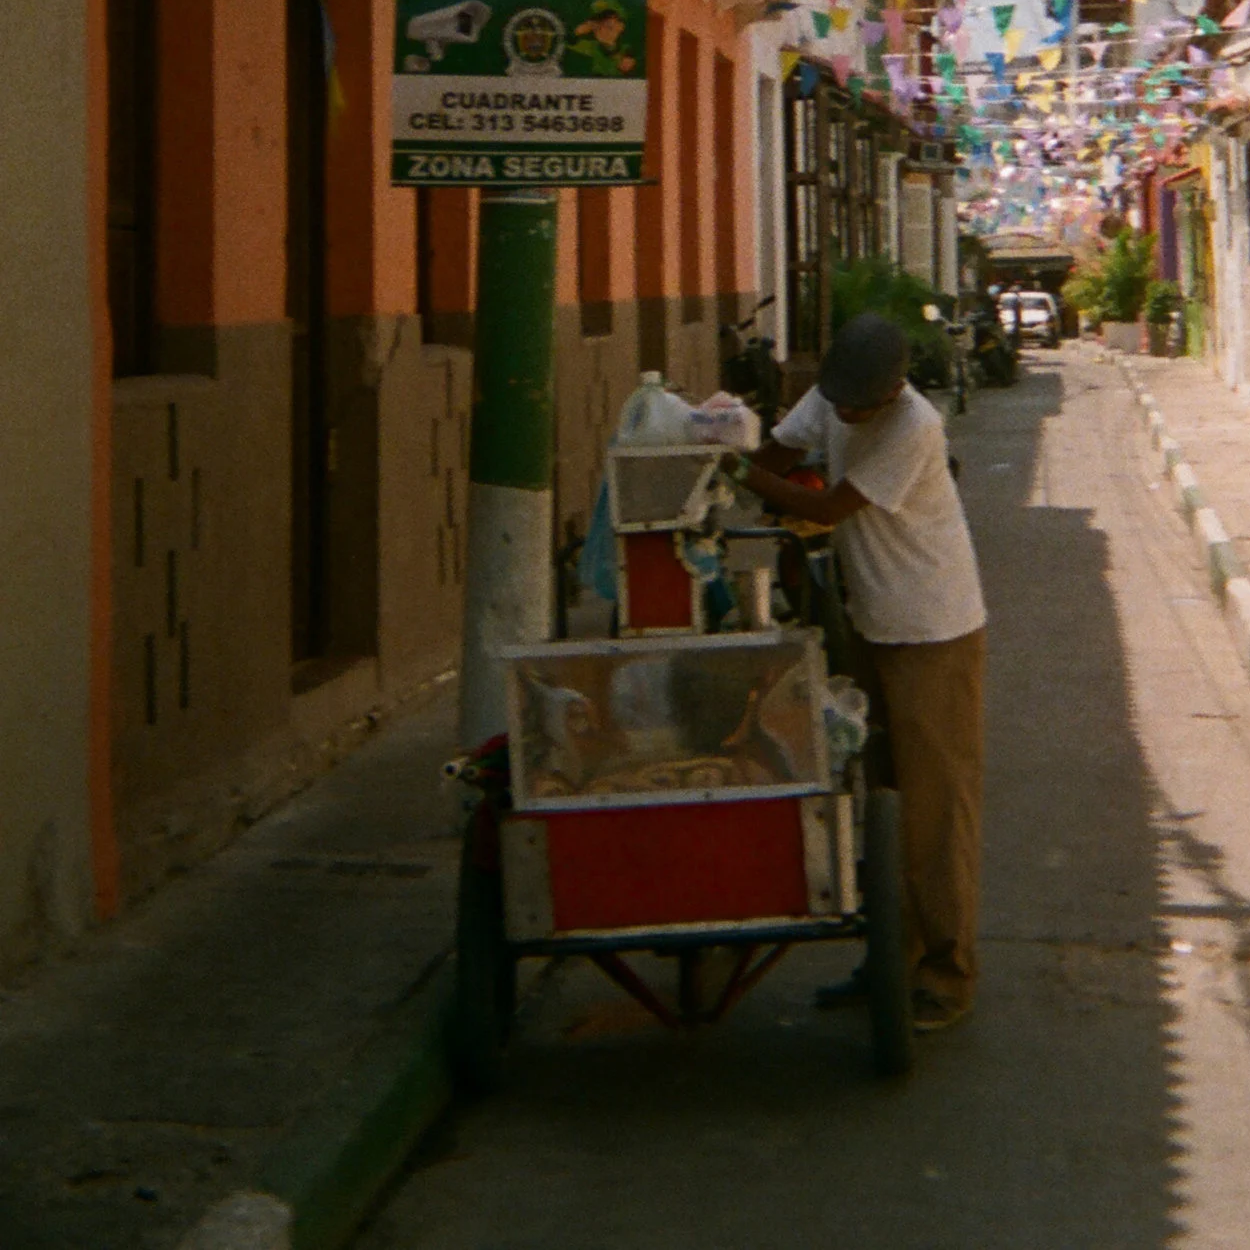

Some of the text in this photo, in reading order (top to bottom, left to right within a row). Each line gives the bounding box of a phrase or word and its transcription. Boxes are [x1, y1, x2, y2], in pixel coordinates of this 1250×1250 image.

[441, 92, 593, 111] CUADRANTE
[409, 113, 464, 131] CEL:
[471, 114, 514, 131] 313
[407, 156, 629, 178] ZONA SEGURA
